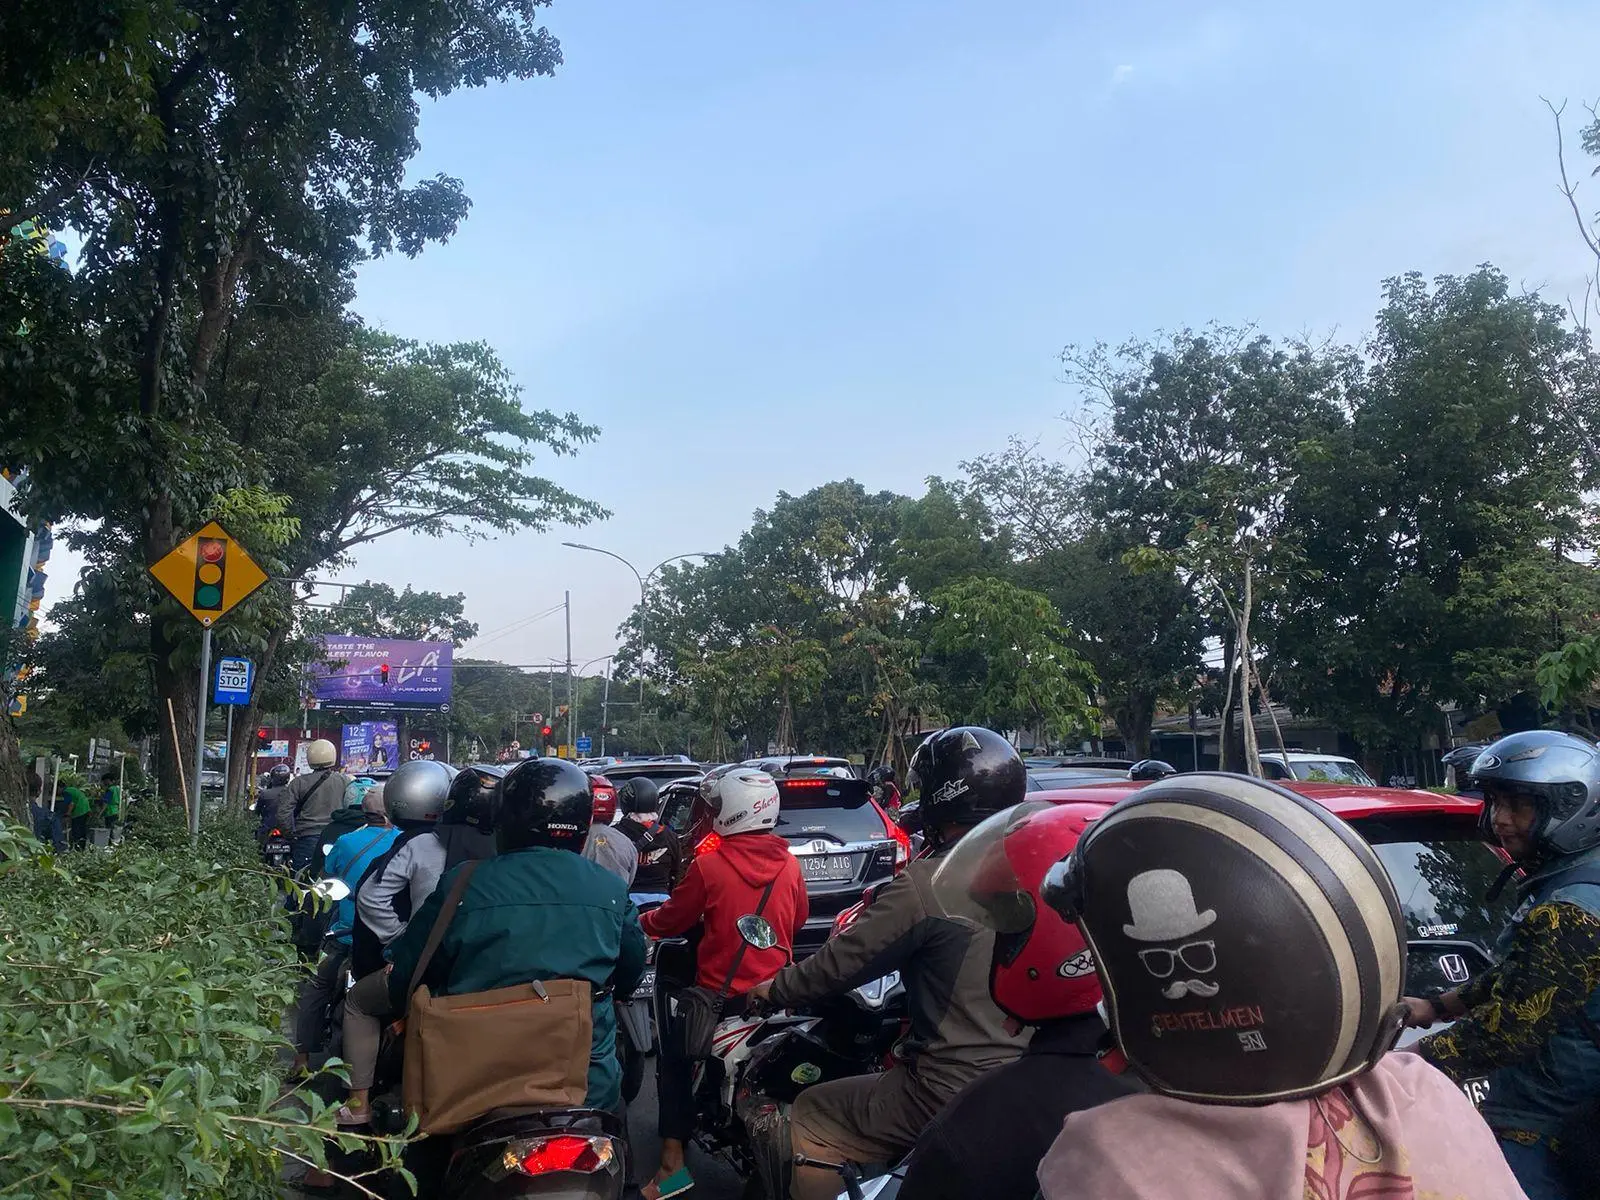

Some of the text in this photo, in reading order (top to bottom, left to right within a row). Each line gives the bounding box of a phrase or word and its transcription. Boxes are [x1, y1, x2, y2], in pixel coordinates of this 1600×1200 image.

[219, 675, 247, 687] STOP
[349, 726, 359, 737] 12
[547, 823, 578, 831] HONDA
[803, 857, 826, 870] 1254
[1237, 1030, 1267, 1052] SNI
